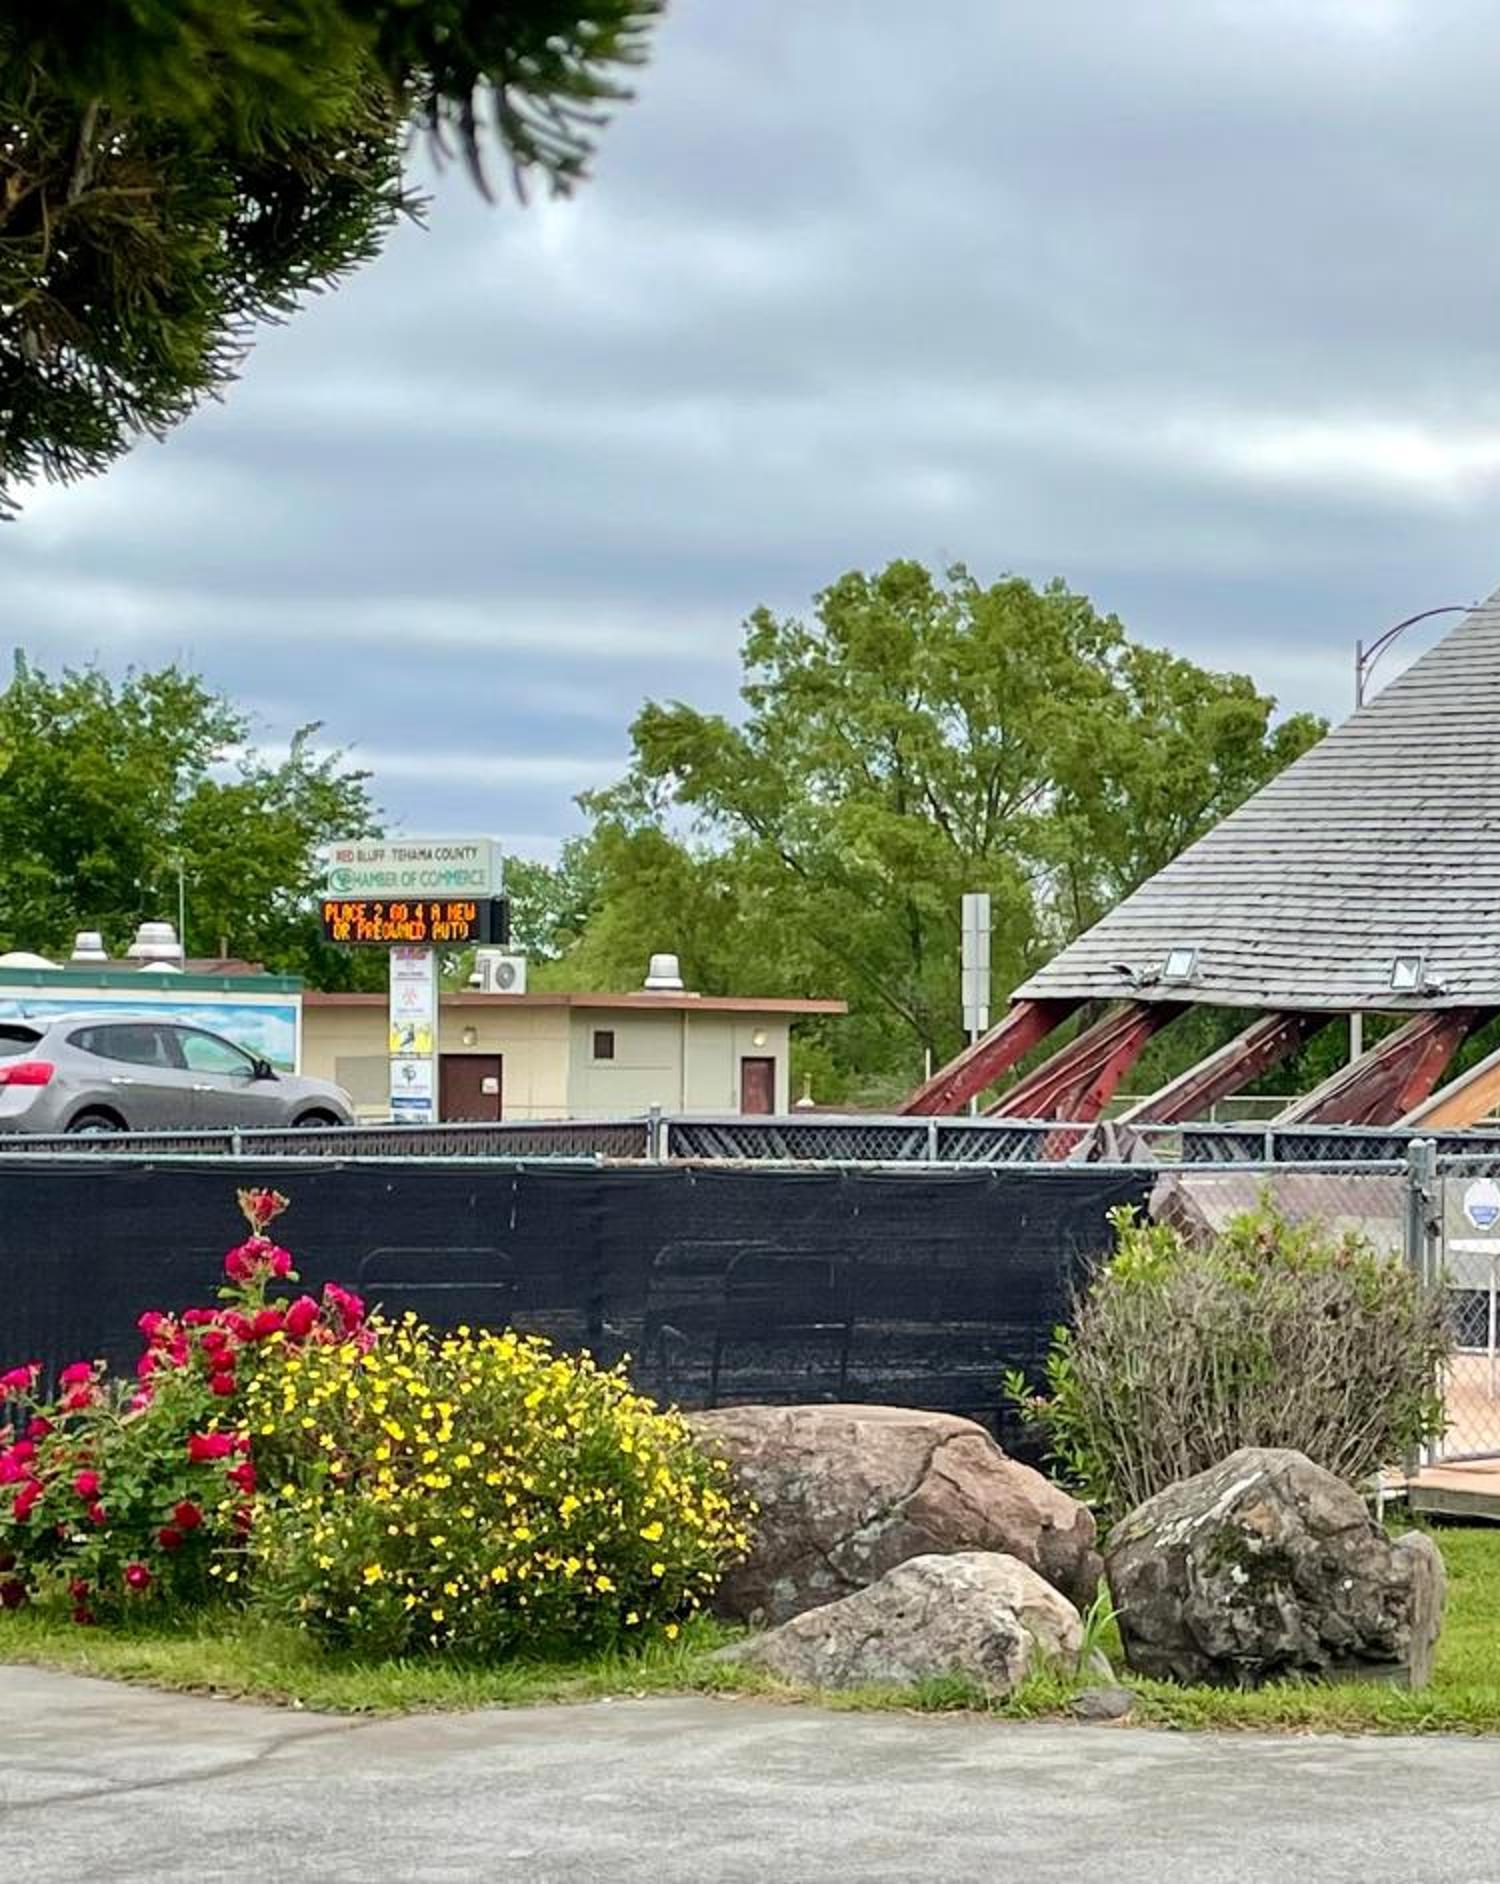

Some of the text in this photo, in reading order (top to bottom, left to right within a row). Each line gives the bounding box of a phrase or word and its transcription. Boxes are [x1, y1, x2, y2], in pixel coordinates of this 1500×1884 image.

[434, 846, 478, 861] COUNTY
[401, 871, 417, 887] OF
[419, 868, 485, 887] COMMERCE
[325, 903, 476, 922] PLACE 2 GO 4 A NEW
[333, 920, 469, 940] OR PREOWNED AUTO
